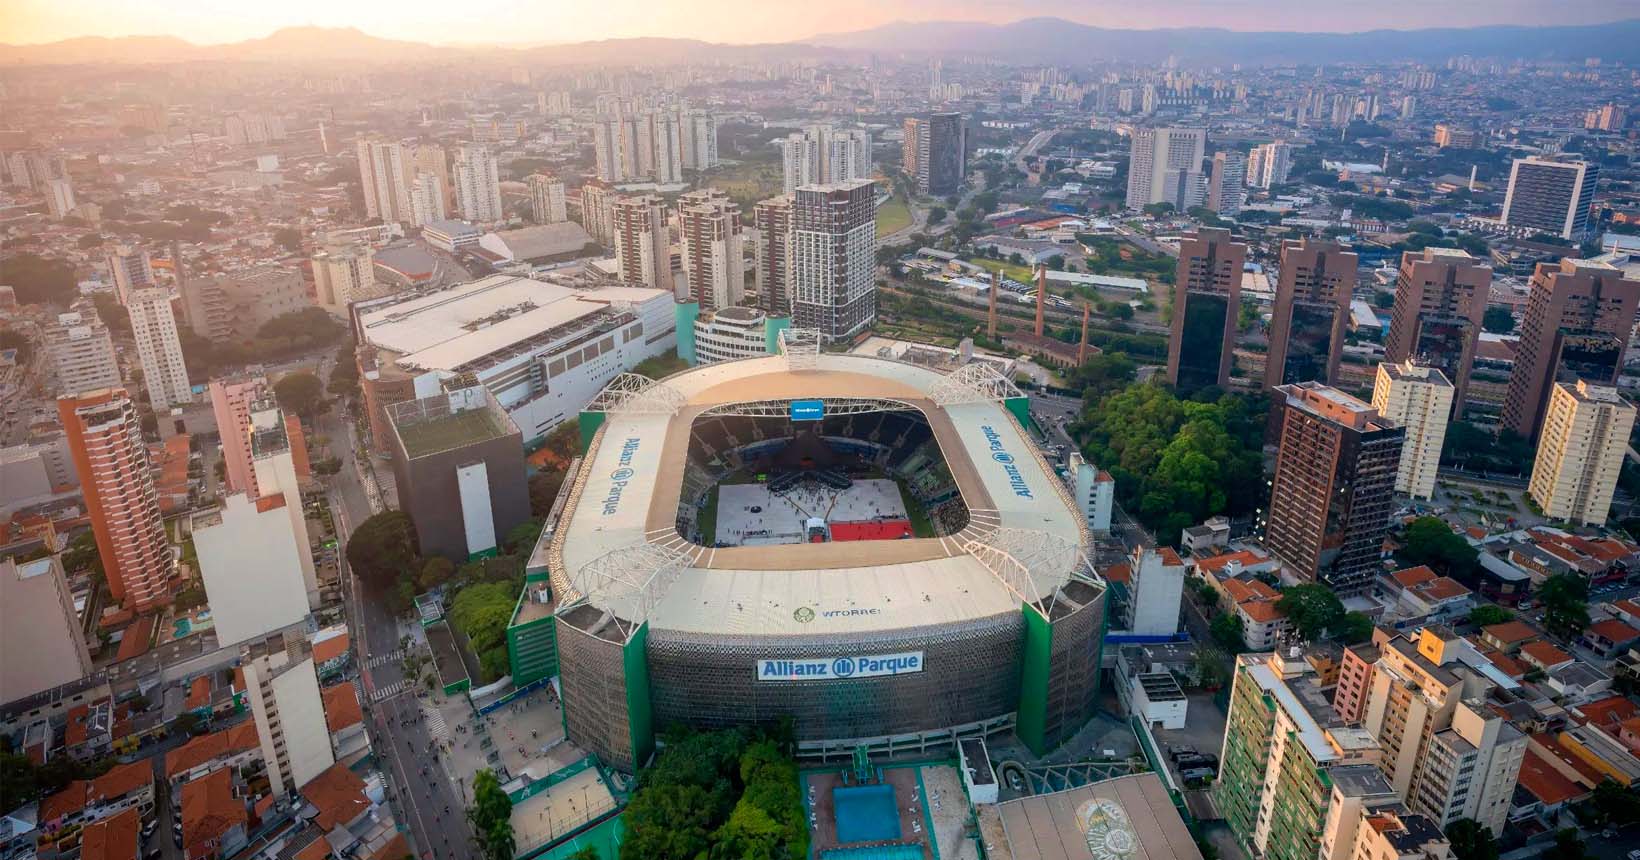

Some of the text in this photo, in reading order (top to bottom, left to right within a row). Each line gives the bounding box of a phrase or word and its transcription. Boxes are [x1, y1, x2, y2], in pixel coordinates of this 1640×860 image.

[601, 438, 641, 516] Allianz Parque
[981, 425, 1034, 500] Allianz Parque
[763, 655, 918, 676] Allianz Parque
